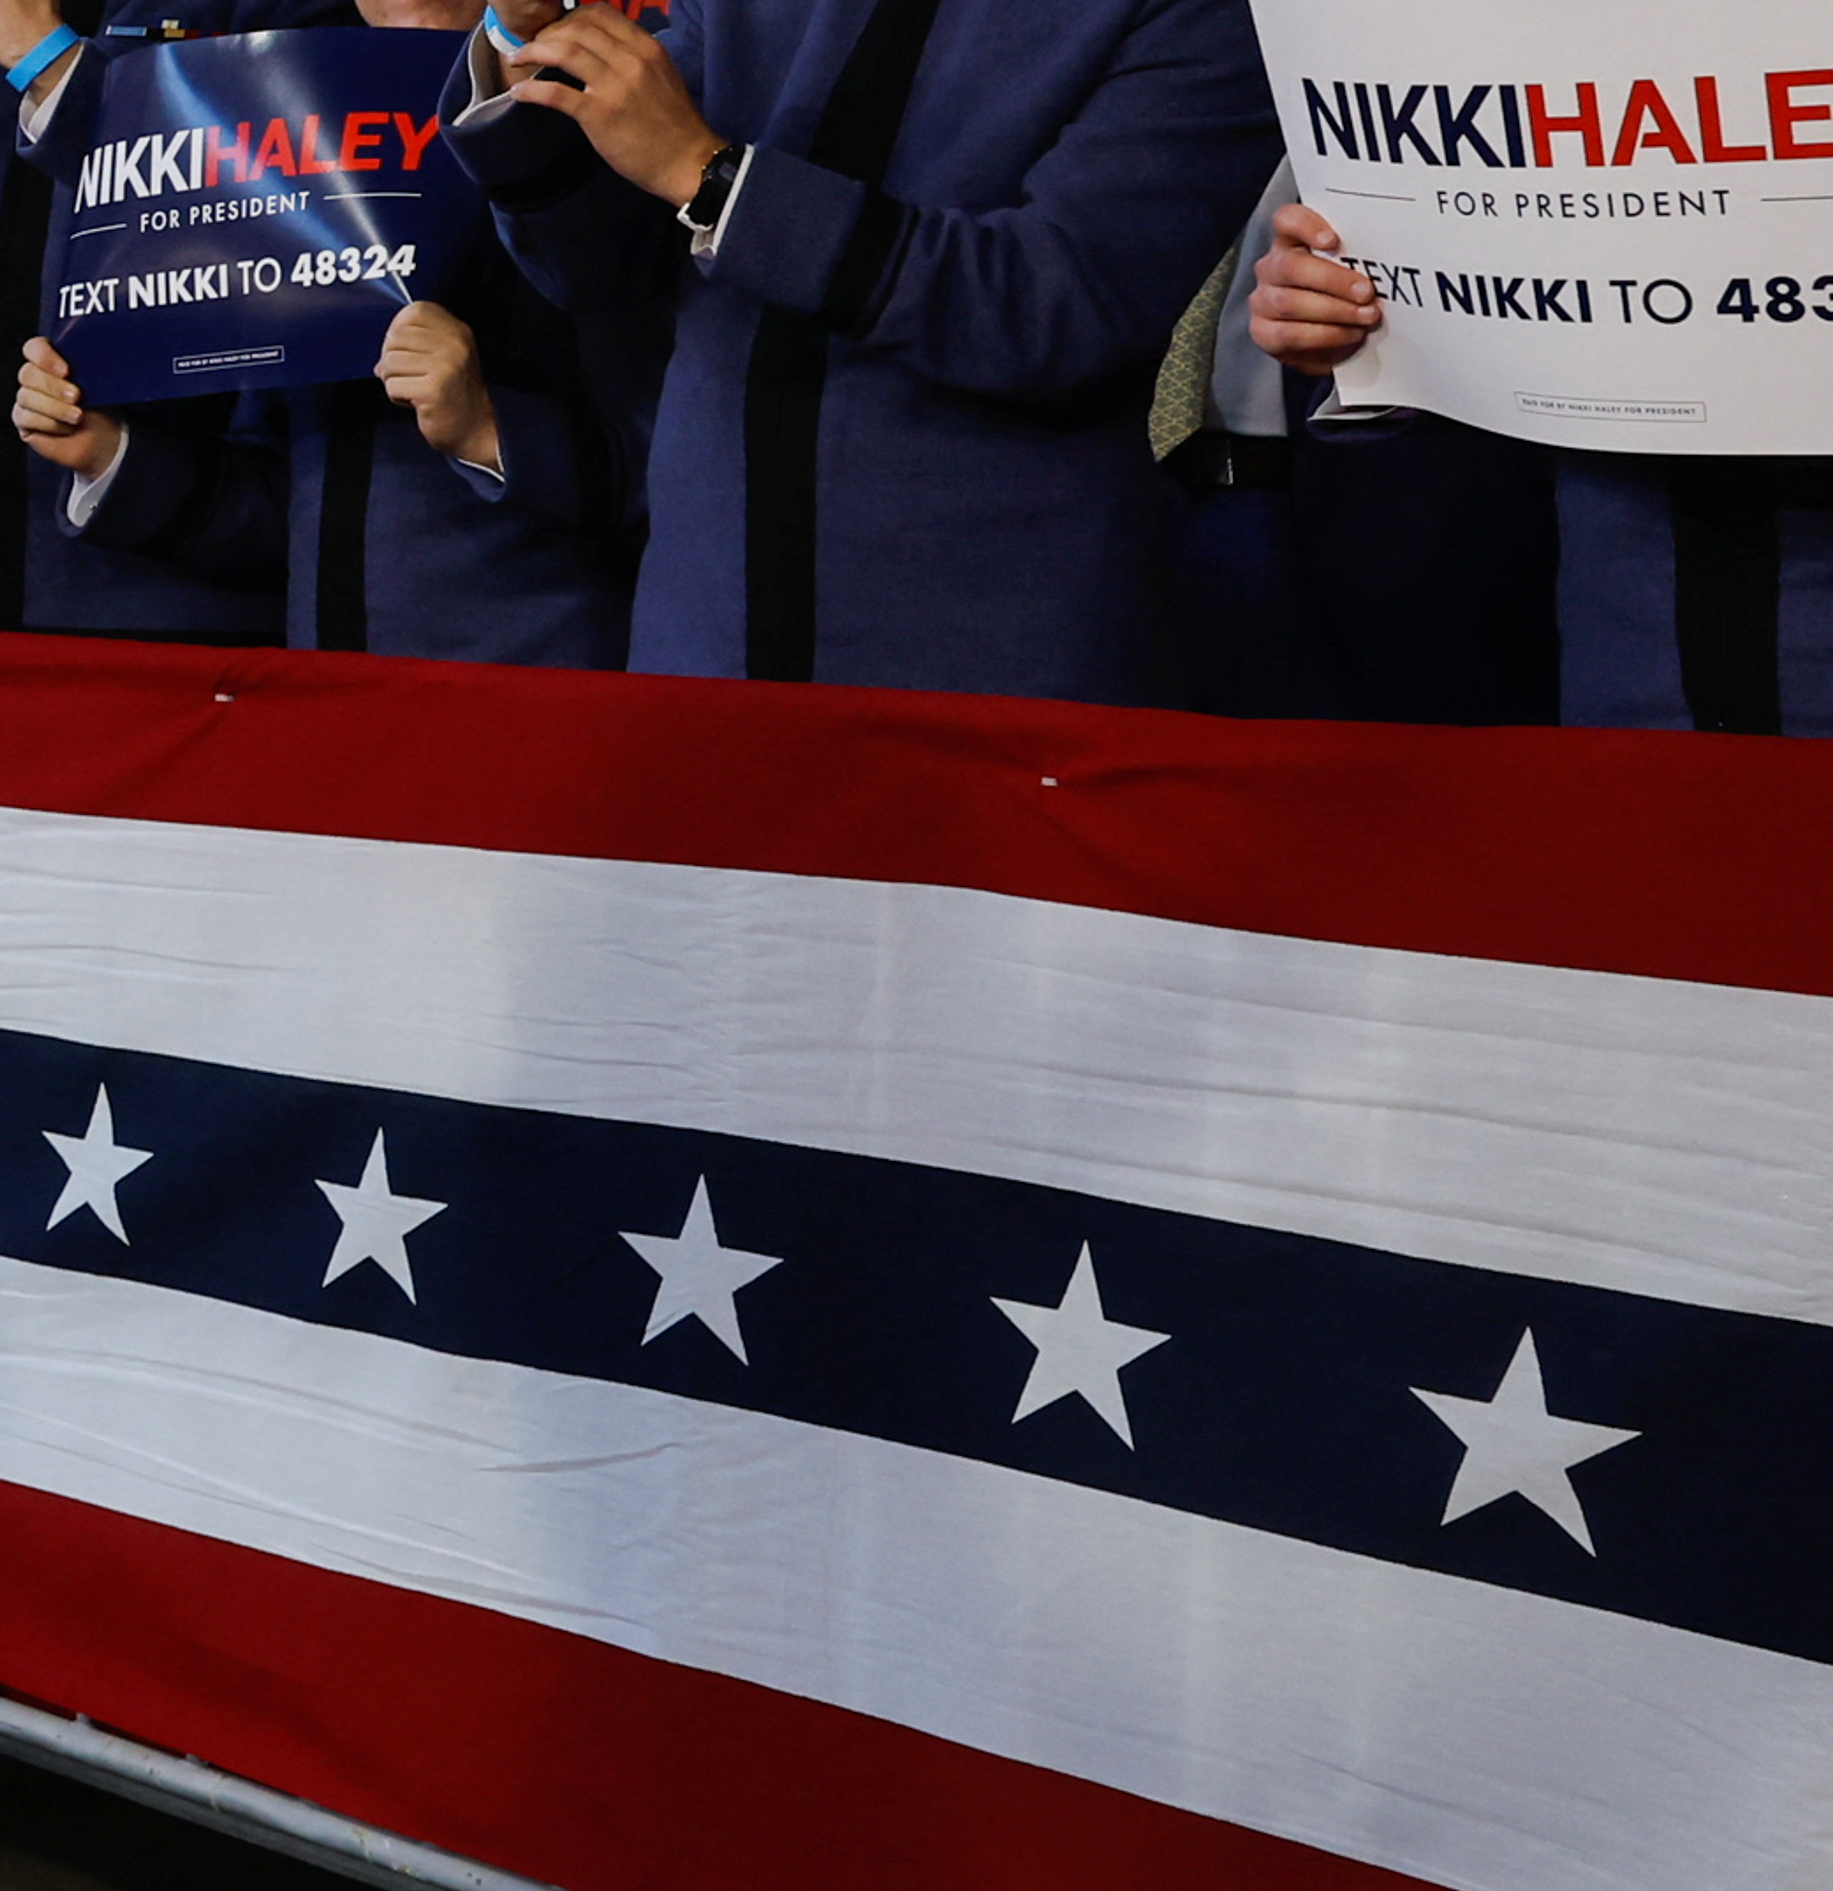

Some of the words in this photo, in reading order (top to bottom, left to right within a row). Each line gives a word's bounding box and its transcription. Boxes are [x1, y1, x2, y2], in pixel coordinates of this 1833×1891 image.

[73, 111, 440, 214] NIKKIHALEY
[139, 211, 181, 233] FOR
[189, 191, 311, 226] PRESIDENT
[1436, 191, 1499, 217] FOR
[1516, 190, 1731, 218] PRESIDENT
[58, 278, 119, 318] TEXT
[128, 263, 229, 309] NIKKI
[237, 257, 281, 295] TO
[290, 244, 416, 288] 48324
[1435, 271, 1594, 323] NIKKI
[1609, 278, 1693, 324] TO
